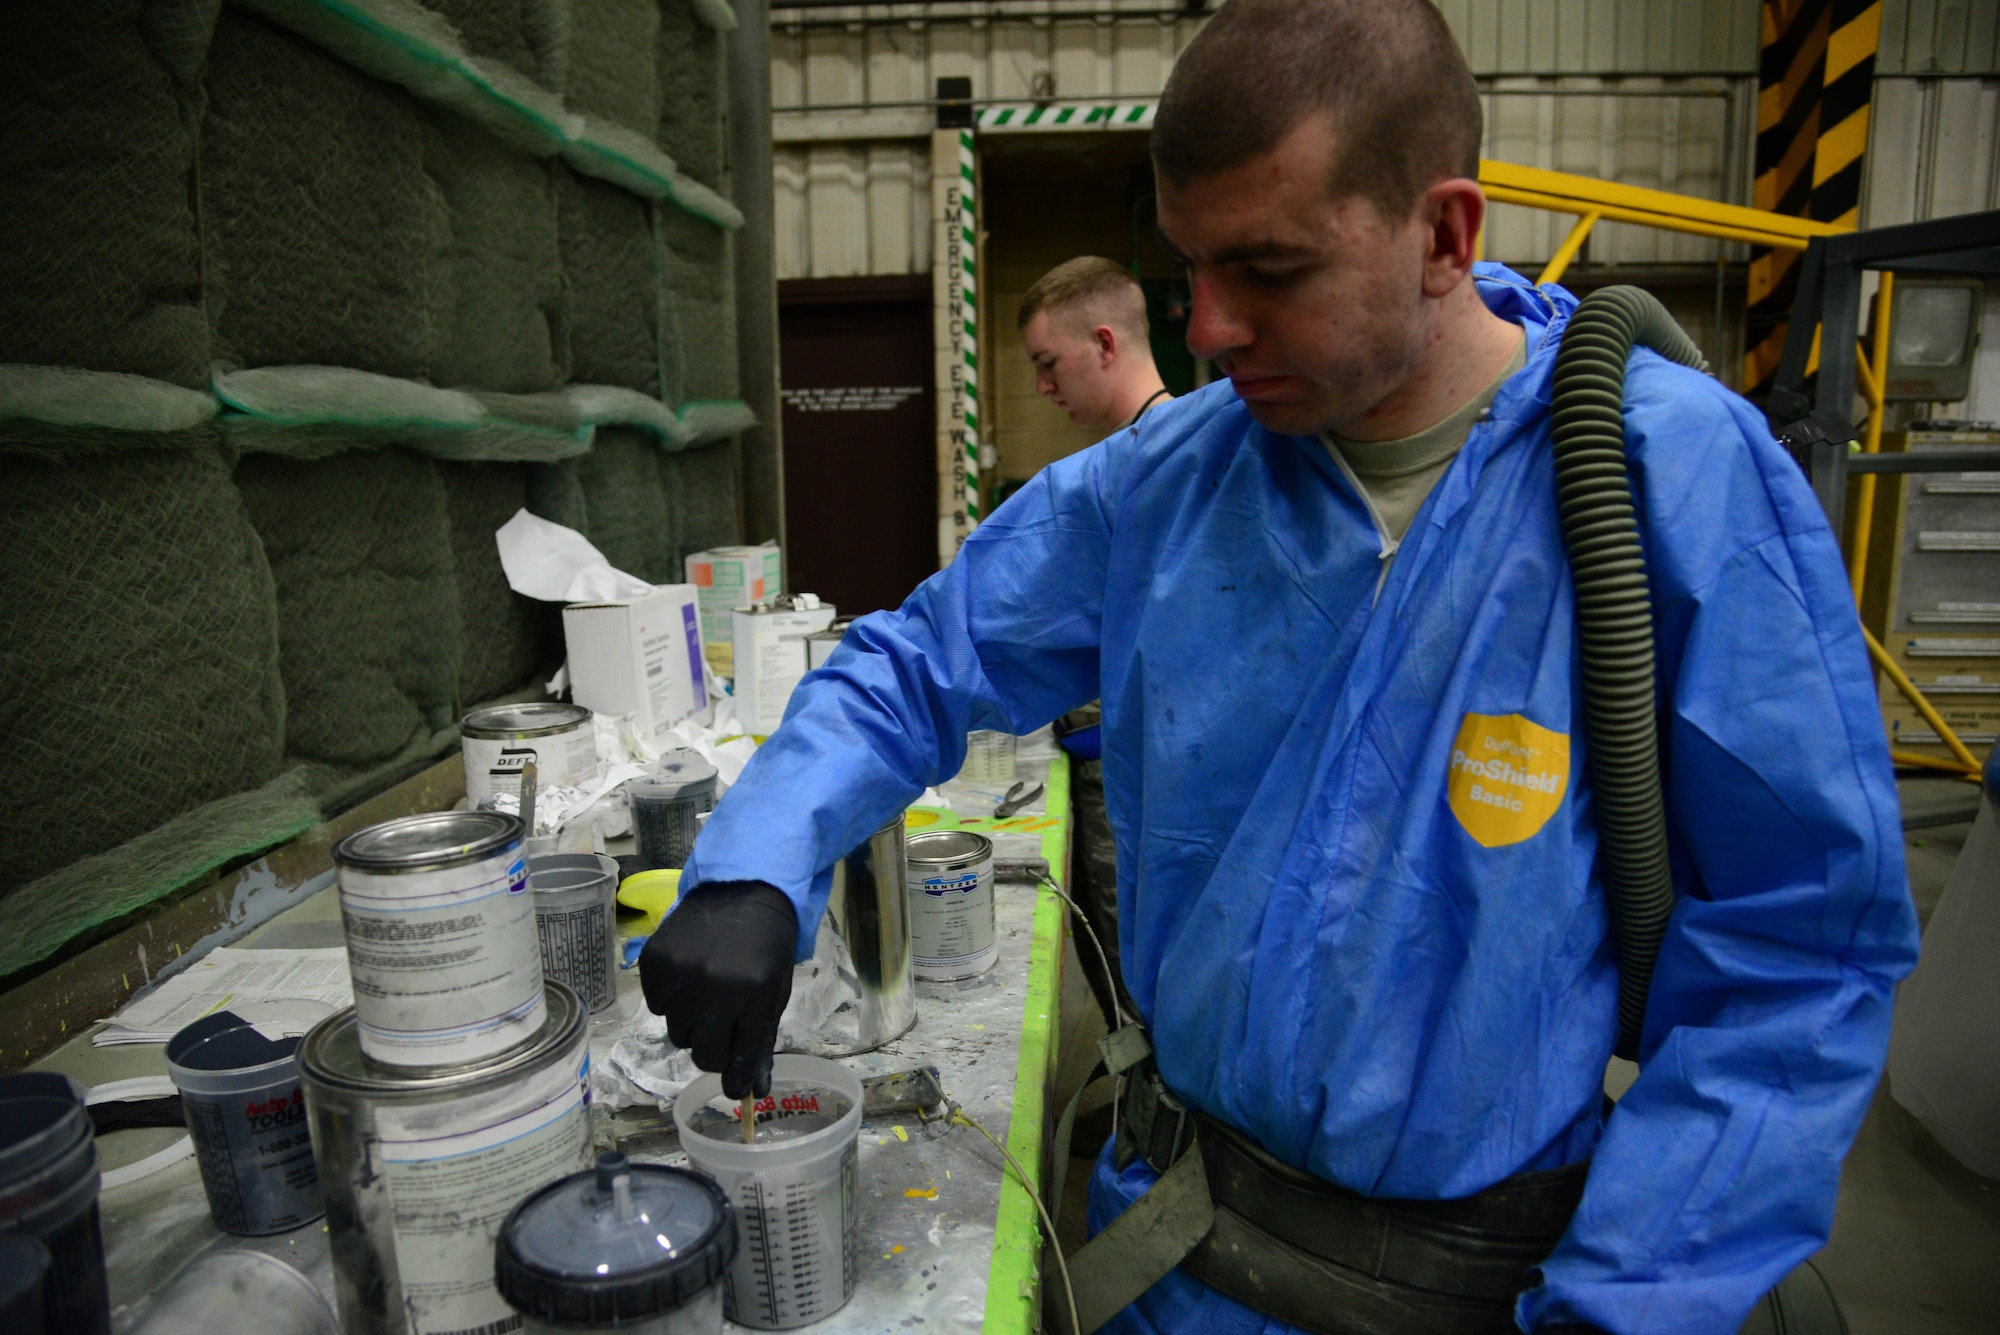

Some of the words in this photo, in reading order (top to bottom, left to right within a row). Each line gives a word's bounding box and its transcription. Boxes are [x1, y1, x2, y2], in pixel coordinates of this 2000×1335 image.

[950, 429, 967, 500] WASH
[497, 756, 534, 766] DEFT
[1451, 750, 1560, 795] ProShield
[1470, 784, 1523, 813] Basic
[924, 878, 978, 891] HENTZEN
[246, 1096, 288, 1118] Auto
